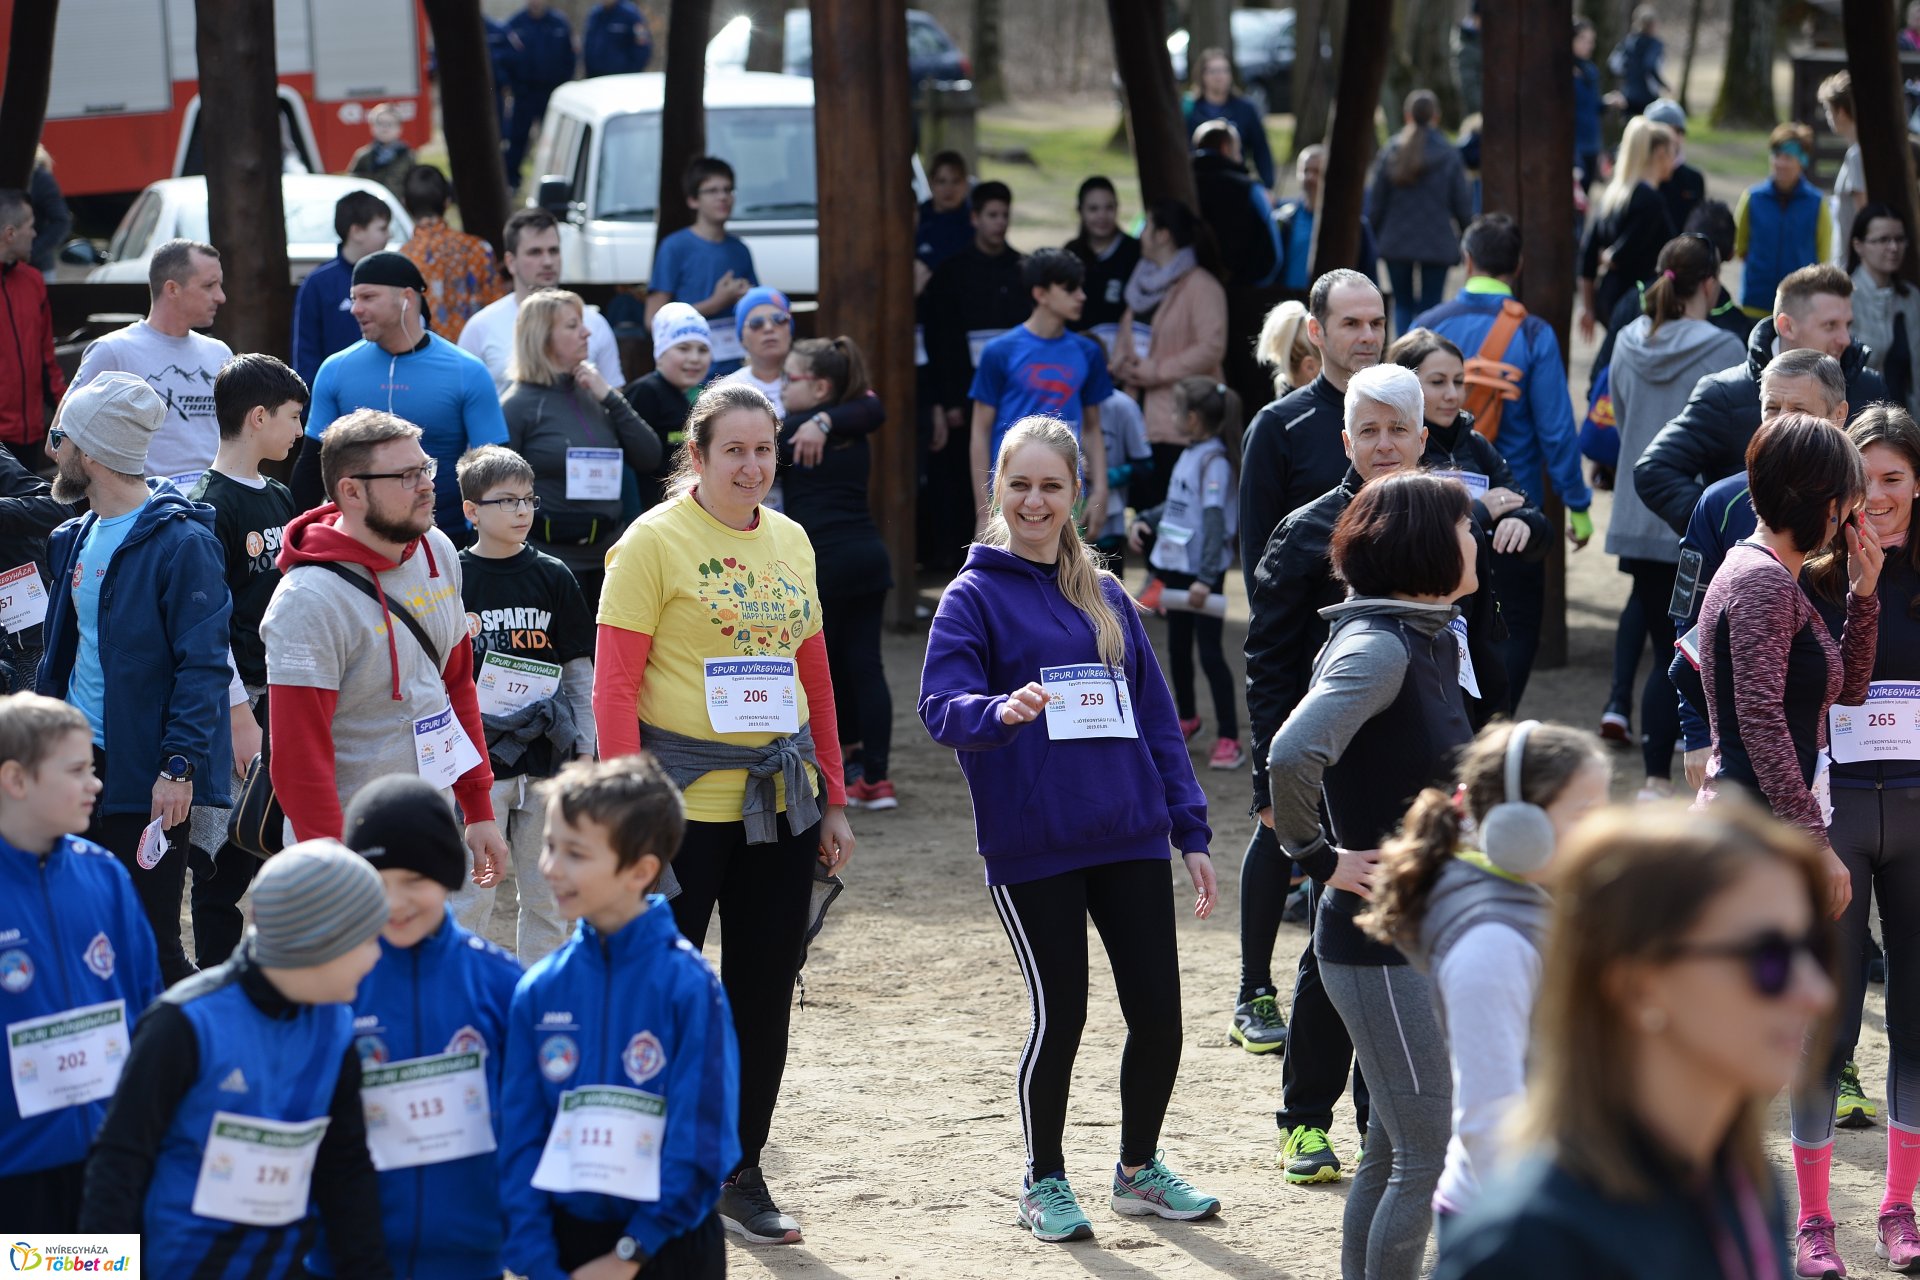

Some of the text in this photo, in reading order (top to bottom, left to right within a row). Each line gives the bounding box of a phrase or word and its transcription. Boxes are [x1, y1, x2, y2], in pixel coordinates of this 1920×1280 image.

[739, 601, 785, 612] THIS IS MY
[742, 612, 786, 621] HAPPY PLACE
[490, 657, 556, 676] SPURI NYÍREGYHÁZA
[712, 663, 791, 674] SPURI NYÍREGYHÁZA
[1049, 668, 1122, 680] SPURI NYÍREGYHZA
[506, 682, 529, 695] 177
[743, 690, 768, 702] 206
[1080, 693, 1103, 706] 259
[420, 719, 441, 732] SPURI
[1868, 713, 1896, 727] 265
[57, 1050, 88, 1072] 202
[408, 1097, 444, 1121] 113
[581, 1126, 612, 1146] 111
[257, 1164, 290, 1186] 176
